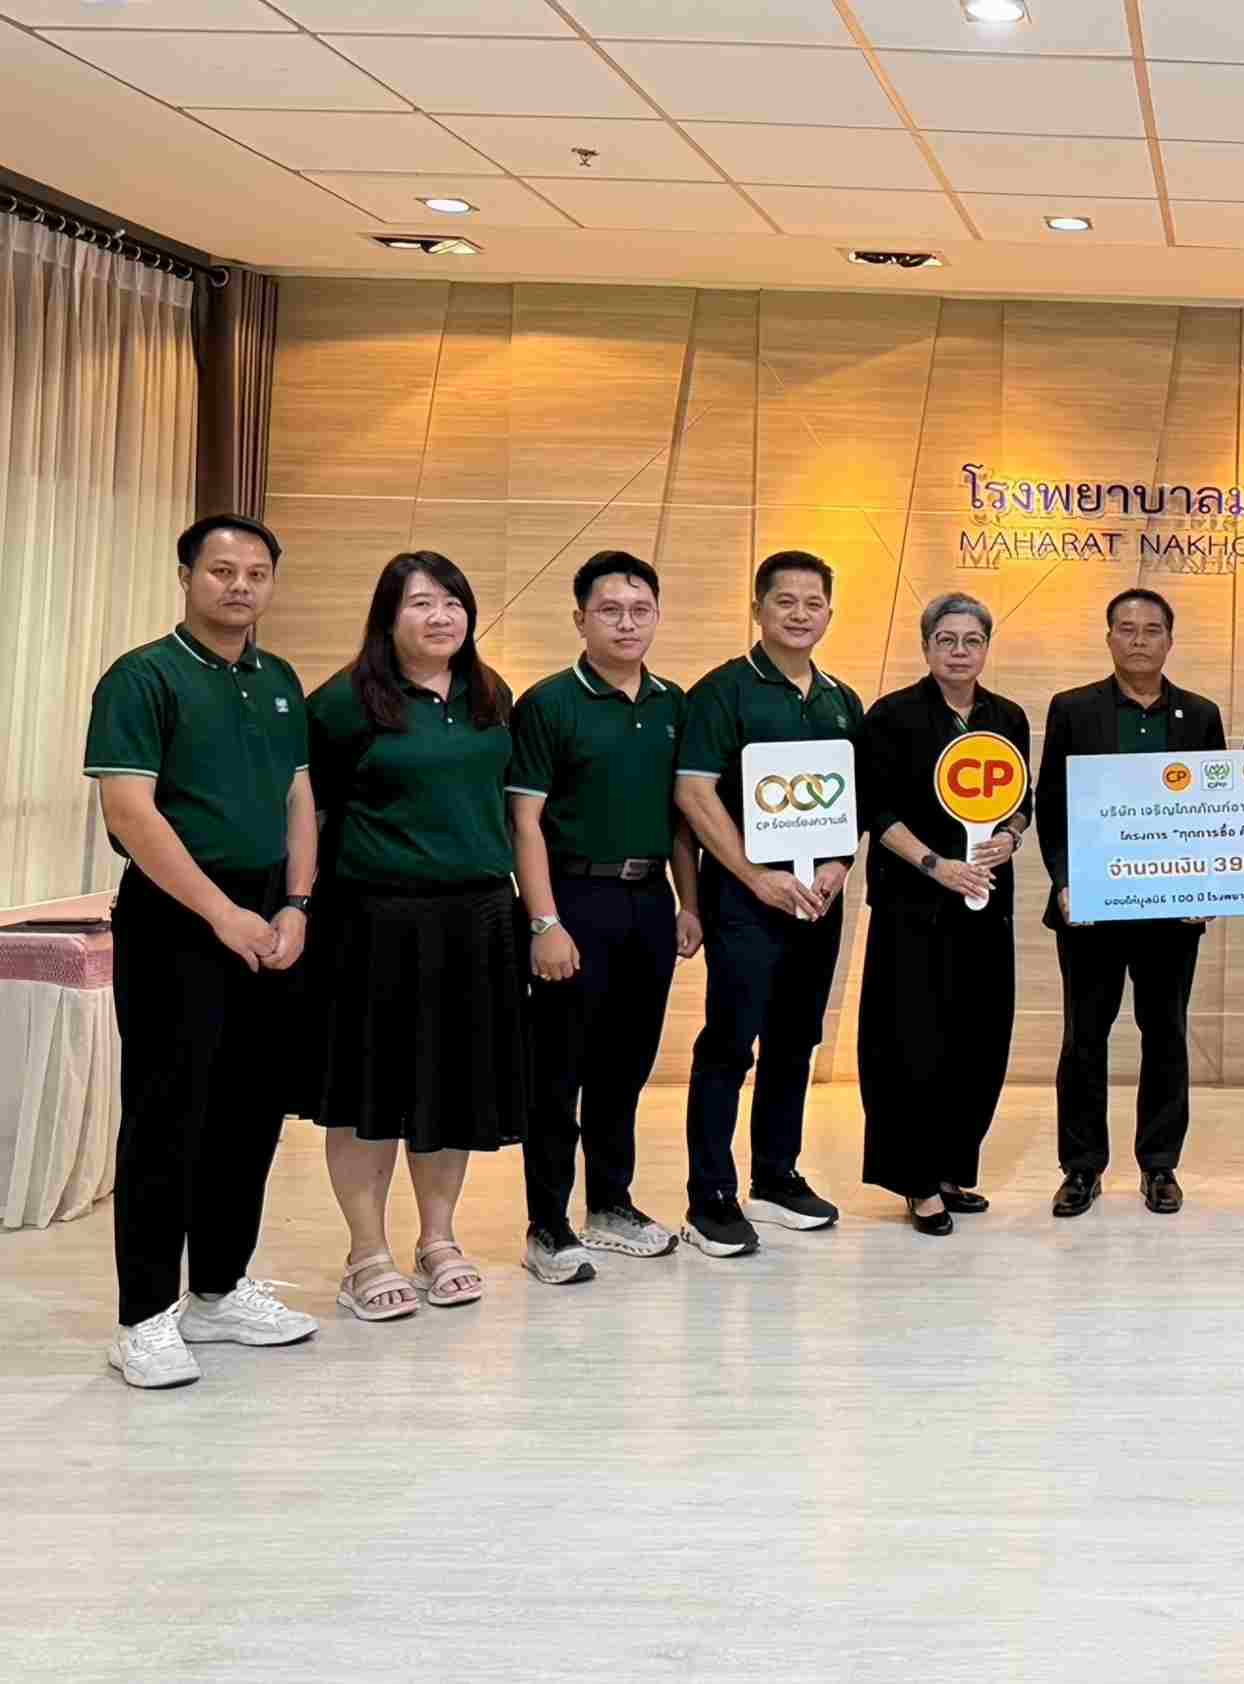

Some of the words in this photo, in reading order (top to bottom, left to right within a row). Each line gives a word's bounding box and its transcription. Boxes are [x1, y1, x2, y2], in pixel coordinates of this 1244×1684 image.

[959, 530, 1122, 559] MAHARAT
[948, 758, 1014, 798] CP
[1166, 770, 1187, 782] CP
[1110, 857, 1206, 876] จำนวนเงิน
[1171, 894, 1194, 903] 100
